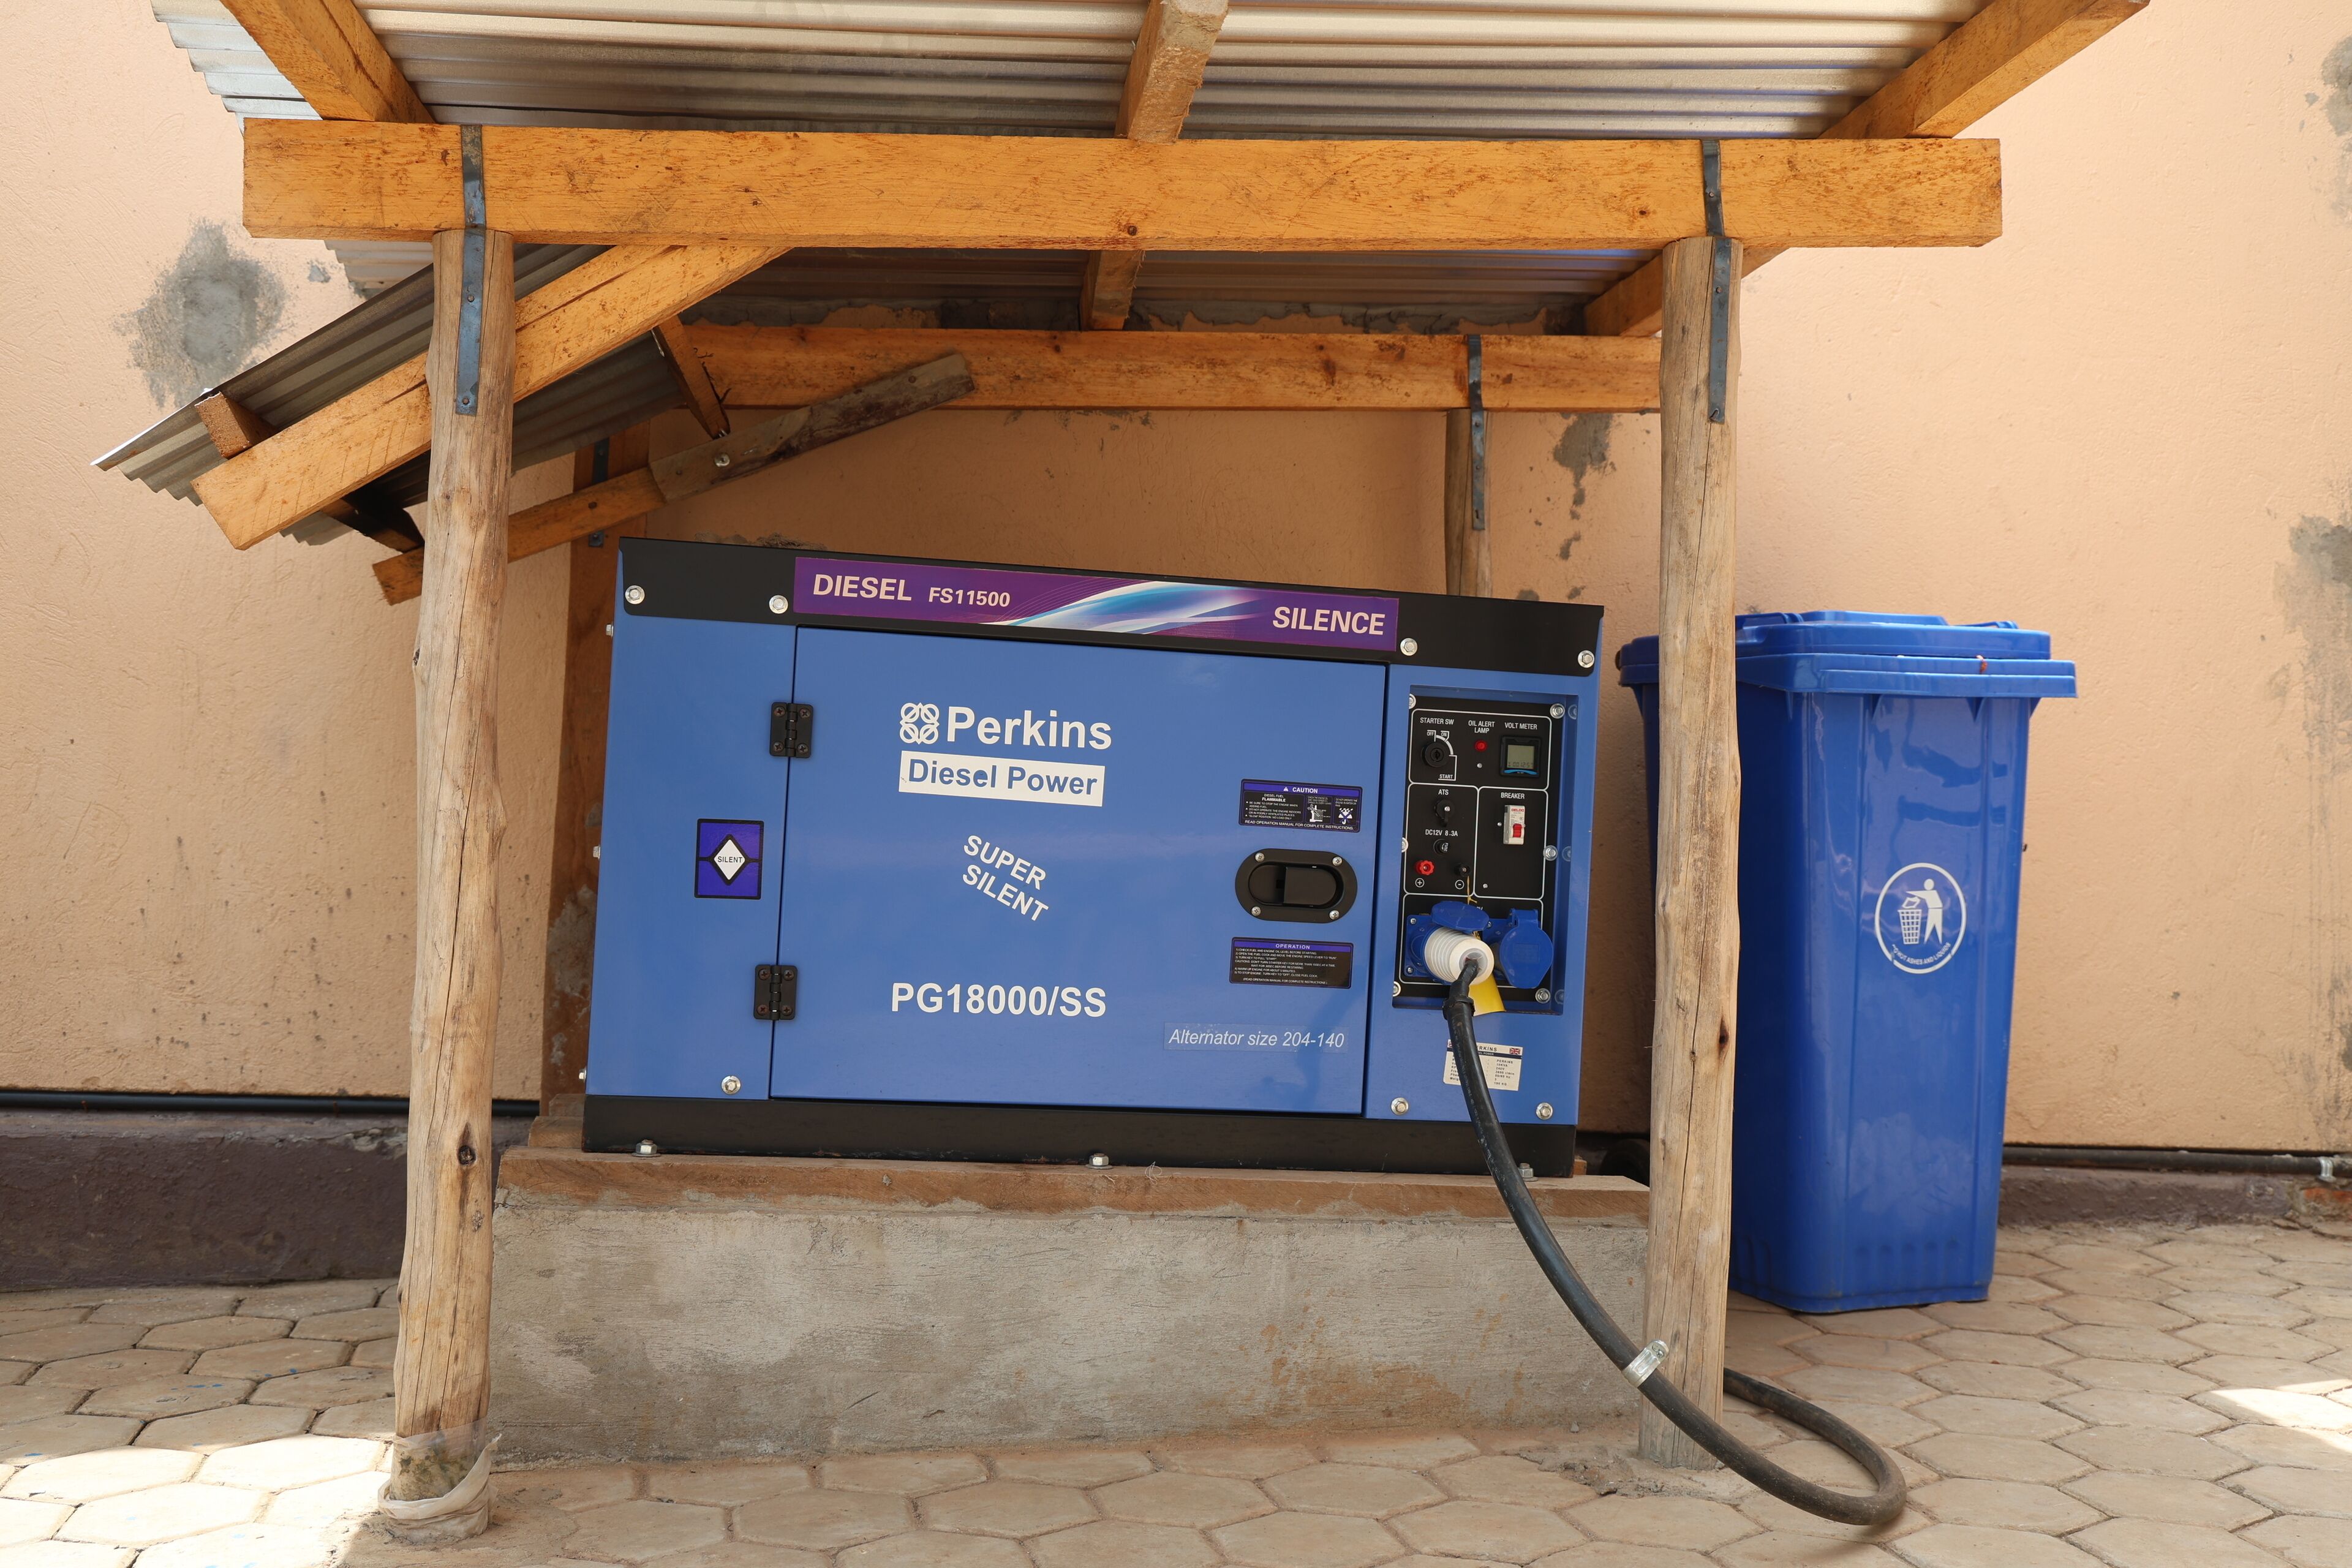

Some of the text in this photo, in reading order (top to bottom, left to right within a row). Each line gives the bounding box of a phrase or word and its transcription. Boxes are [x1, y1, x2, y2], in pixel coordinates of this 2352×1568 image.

[813, 574, 1011, 608] DIESEL FS11500
[1272, 606, 1386, 635] SILENCE
[947, 706, 1112, 750] Perkins
[909, 758, 1098, 795] Diesel Power
[963, 835, 1046, 891] SUPER
[962, 864, 1049, 921] SILENT
[892, 982, 1106, 1017] PG18000/SS
[1168, 1029, 1344, 1048] Alternator size 204-140
